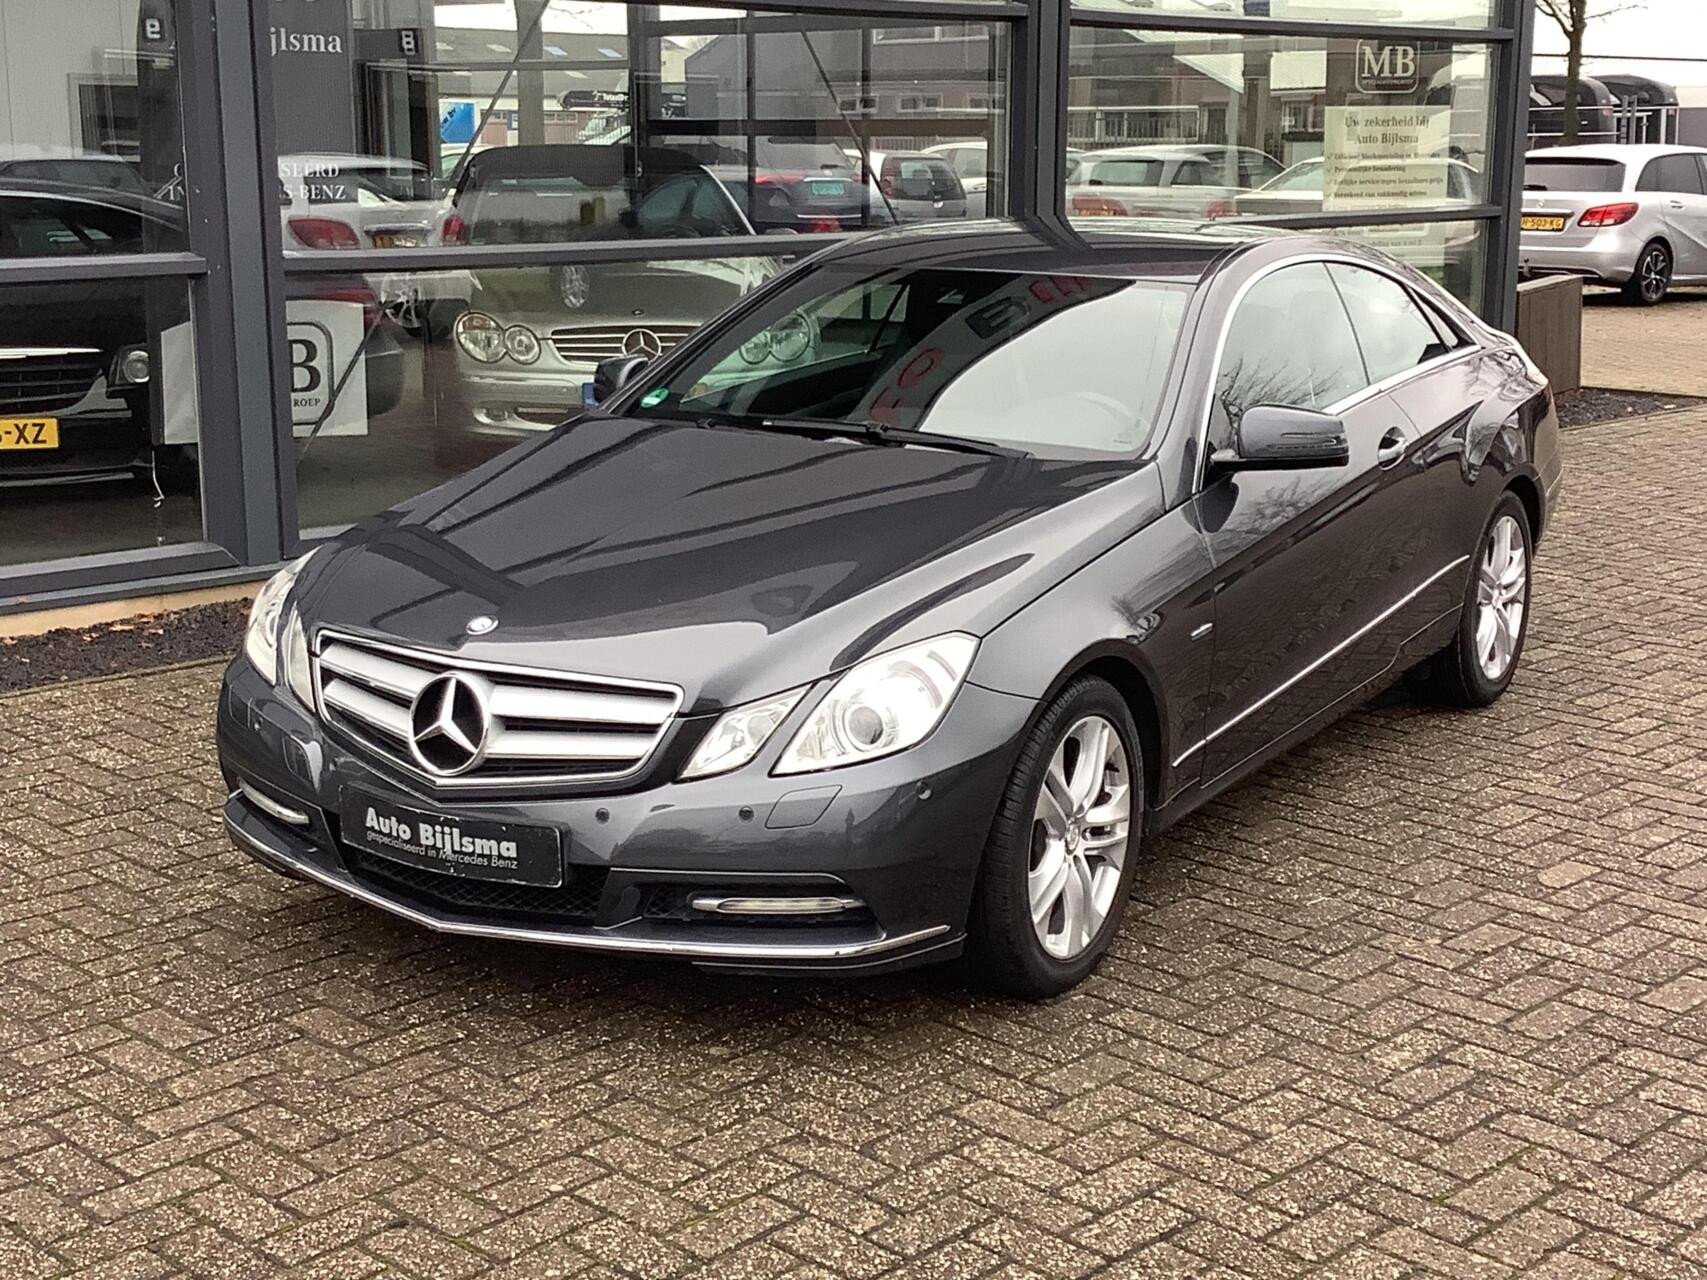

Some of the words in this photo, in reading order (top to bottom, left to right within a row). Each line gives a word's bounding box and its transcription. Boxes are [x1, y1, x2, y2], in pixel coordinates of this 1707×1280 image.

[269, 26, 343, 56] jlsma
[1361, 46, 1415, 77] MB
[1345, 116, 1359, 128] Uw
[1364, 116, 1413, 127] zekerheid
[1415, 115, 1429, 128] bij
[1354, 134, 1379, 144] Auto
[1381, 133, 1418, 146] Bijlsma
[280, 163, 339, 178] SEERD
[280, 184, 346, 200] S-BENZ
[290, 338, 322, 393] B
[293, 398, 321, 408] ROEP
[0, 422, 48, 445] -XZ
[365, 806, 411, 840] Auto
[419, 822, 518, 858] Bijlsma
[366, 829, 426, 856] gespecialiseerd
[427, 848, 437, 858] in
[438, 850, 489, 866] Mercedes
[491, 855, 519, 869] Benz
